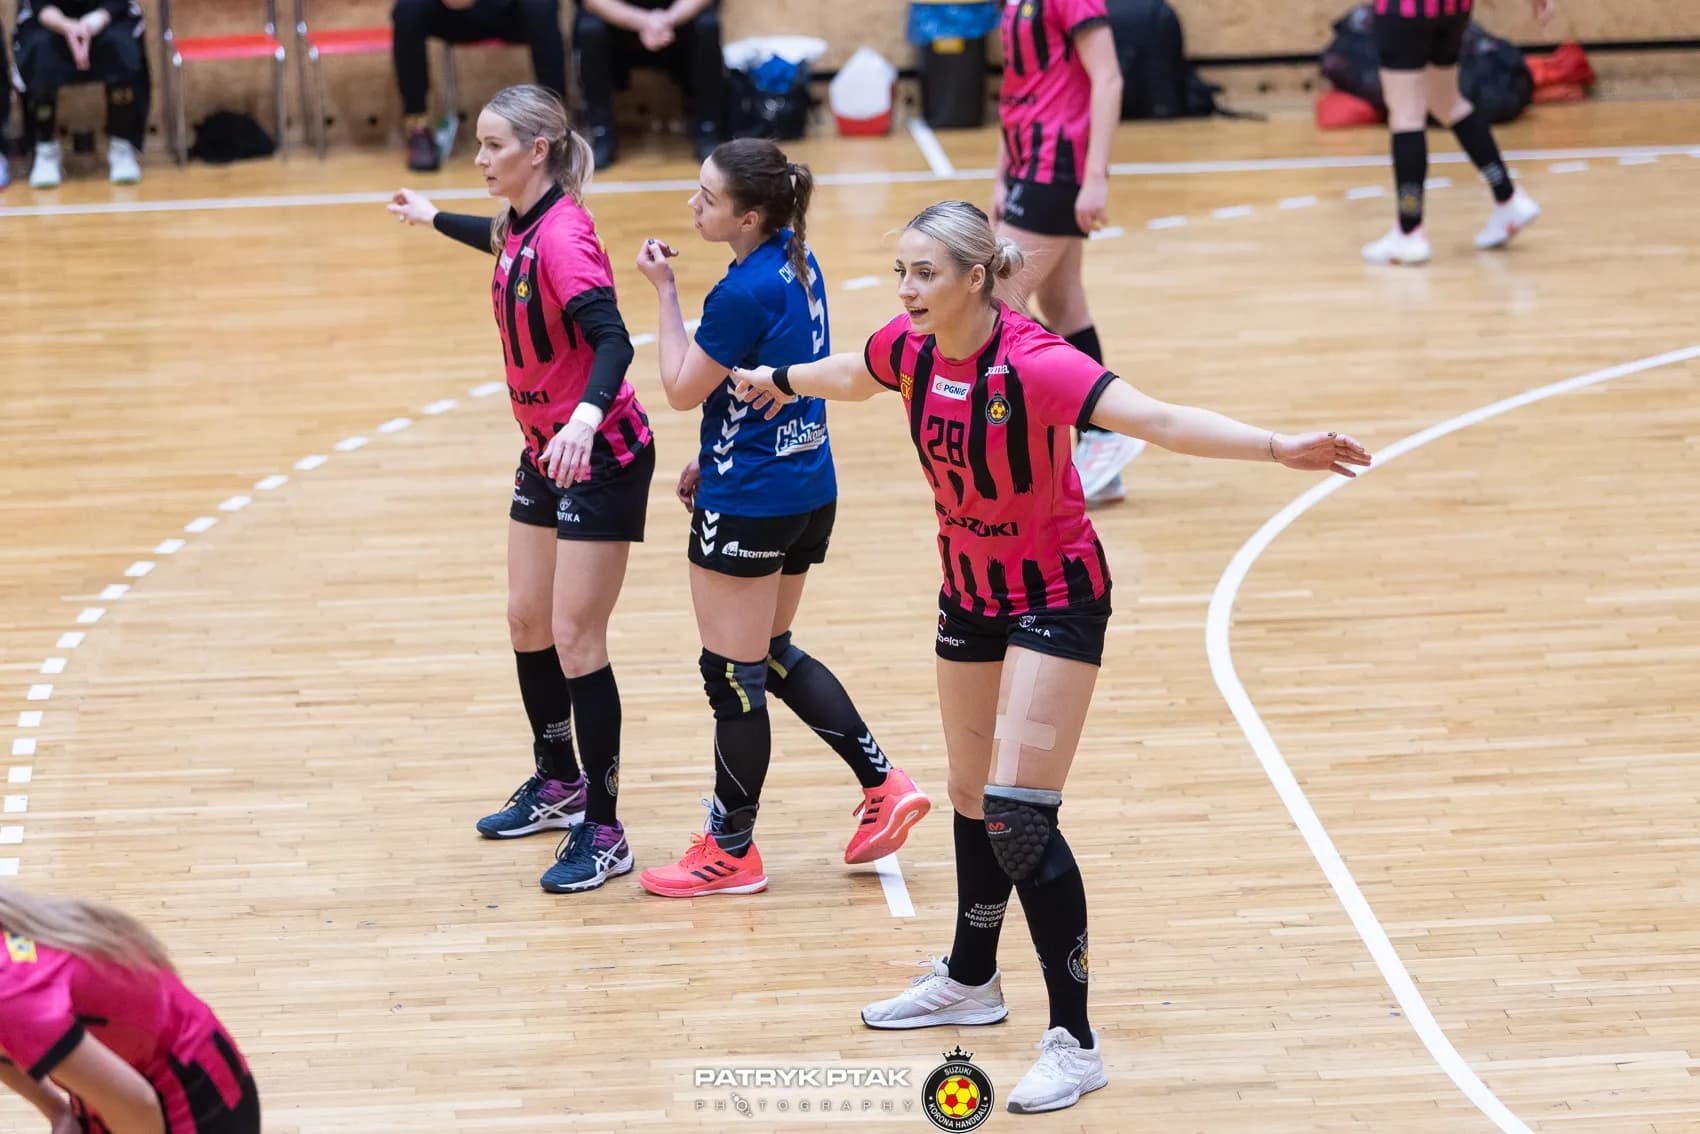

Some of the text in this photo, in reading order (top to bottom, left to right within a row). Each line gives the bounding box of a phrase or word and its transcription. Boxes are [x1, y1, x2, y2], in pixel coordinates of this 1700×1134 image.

[943, 384, 967, 396] PGNiG
[926, 415, 967, 468] 28
[935, 501, 1019, 537] SUZUKI
[970, 920, 999, 929] KIELCE
